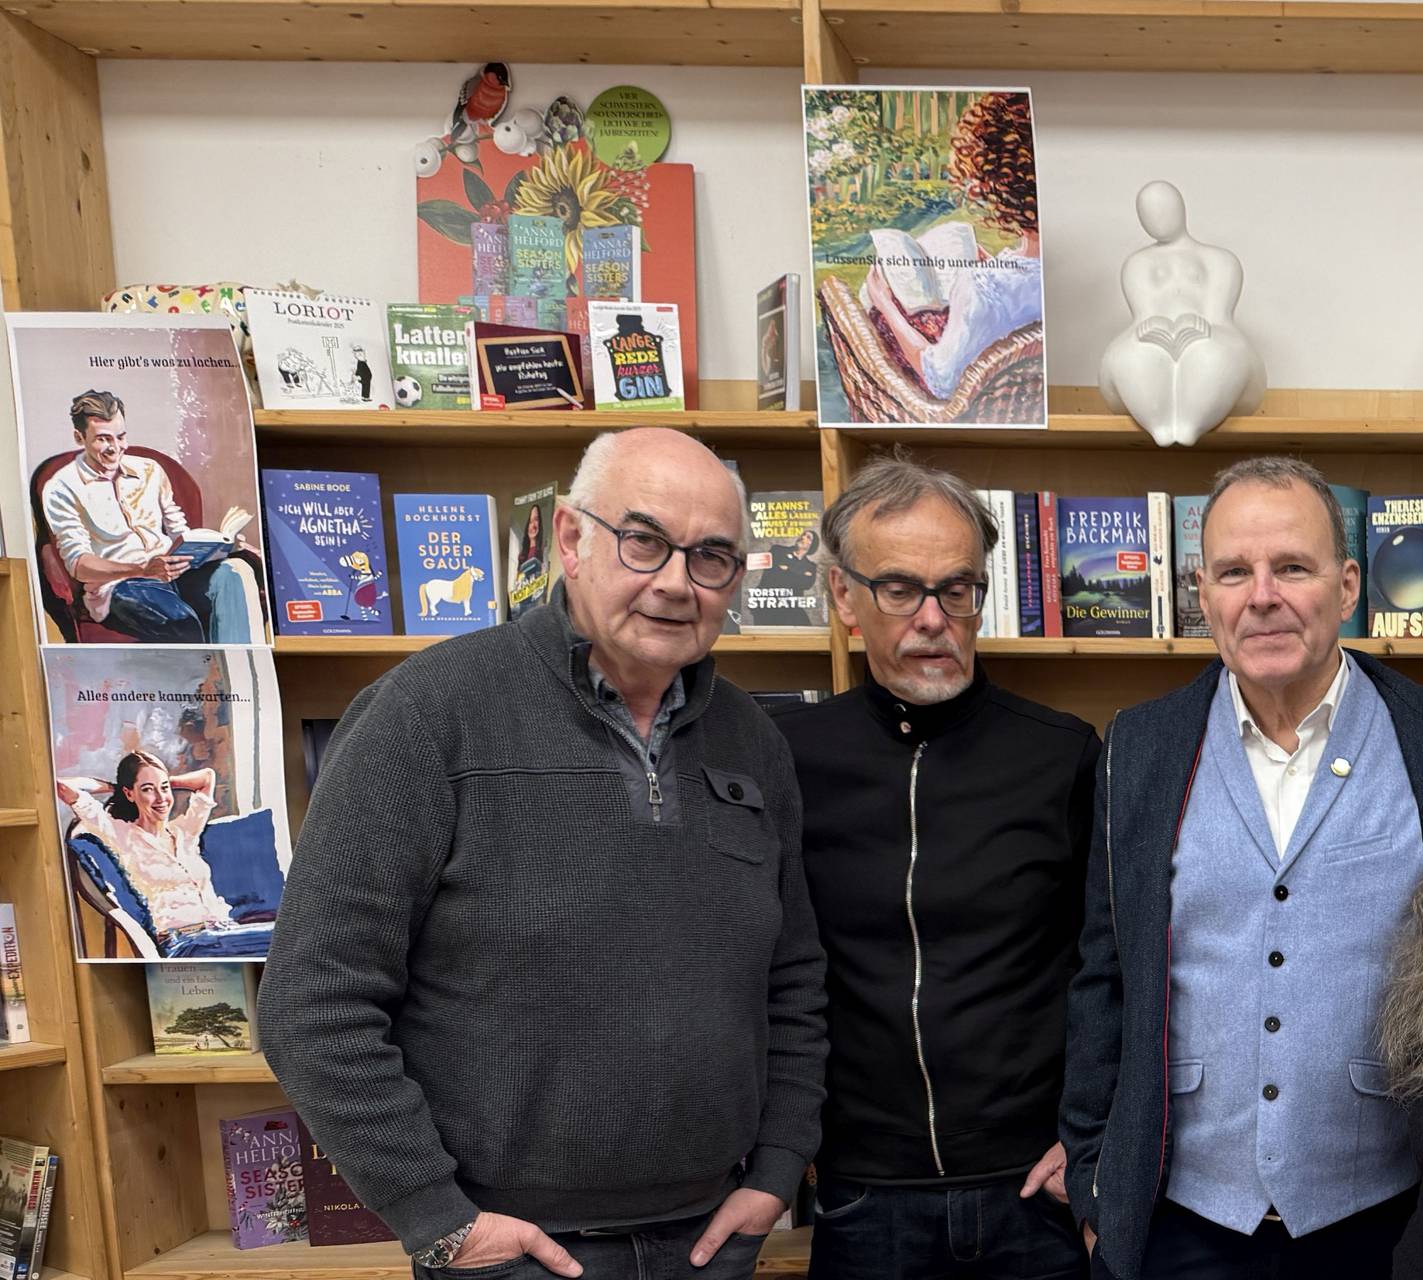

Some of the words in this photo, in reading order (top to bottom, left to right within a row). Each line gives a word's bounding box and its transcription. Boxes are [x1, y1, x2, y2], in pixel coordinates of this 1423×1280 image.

[524, 227, 555, 237] ANNA
[514, 236, 563, 246] HELFORD
[516, 249, 561, 258] SEASON
[584, 249, 631, 259] HELFORD
[517, 258, 561, 269] SISTERS
[585, 262, 630, 272] SEASON
[886, 256, 910, 267] sich
[913, 256, 945, 269] ruhig
[587, 272, 629, 282] SISTERS
[273, 301, 354, 321] LORIOT
[612, 333, 656, 351] LANGE
[89, 356, 115, 368] Hier
[118, 356, 149, 370] gibt's
[150, 358, 175, 368] was
[176, 358, 191, 368] zu
[614, 351, 659, 365] REDE
[619, 376, 664, 399] GIN
[294, 483, 325, 492] SABINE
[327, 483, 351, 492] BODE
[302, 501, 332, 517] WILL
[334, 506, 354, 516] ABER
[418, 505, 466, 513] HELENE
[751, 502, 765, 512] DU
[768, 502, 810, 511] KANNST
[405, 514, 480, 522] BOCKHORST
[755, 511, 787, 520] ALLES
[1068, 511, 1142, 528] FREDRIK
[299, 517, 361, 535] AGNETHA
[428, 532, 461, 544] DER
[753, 528, 804, 538] WOLLEN
[1066, 527, 1147, 545] BACKMAN
[418, 545, 472, 557] SUPER
[423, 557, 470, 570] GAUL
[748, 588, 793, 597] TORSTEN
[748, 597, 816, 609] STRÄTER
[1066, 606, 1087, 618] Die
[1090, 605, 1150, 619] Gewinner
[1371, 612, 1410, 638] AUF
[77, 690, 109, 701] Alles
[111, 691, 155, 701] andere
[158, 691, 192, 702] kann
[181, 985, 215, 996] Leben
[249, 1130, 299, 1150] ANN
[236, 1144, 301, 1165] HELFO
[323, 1203, 361, 1211] NIKOLA
